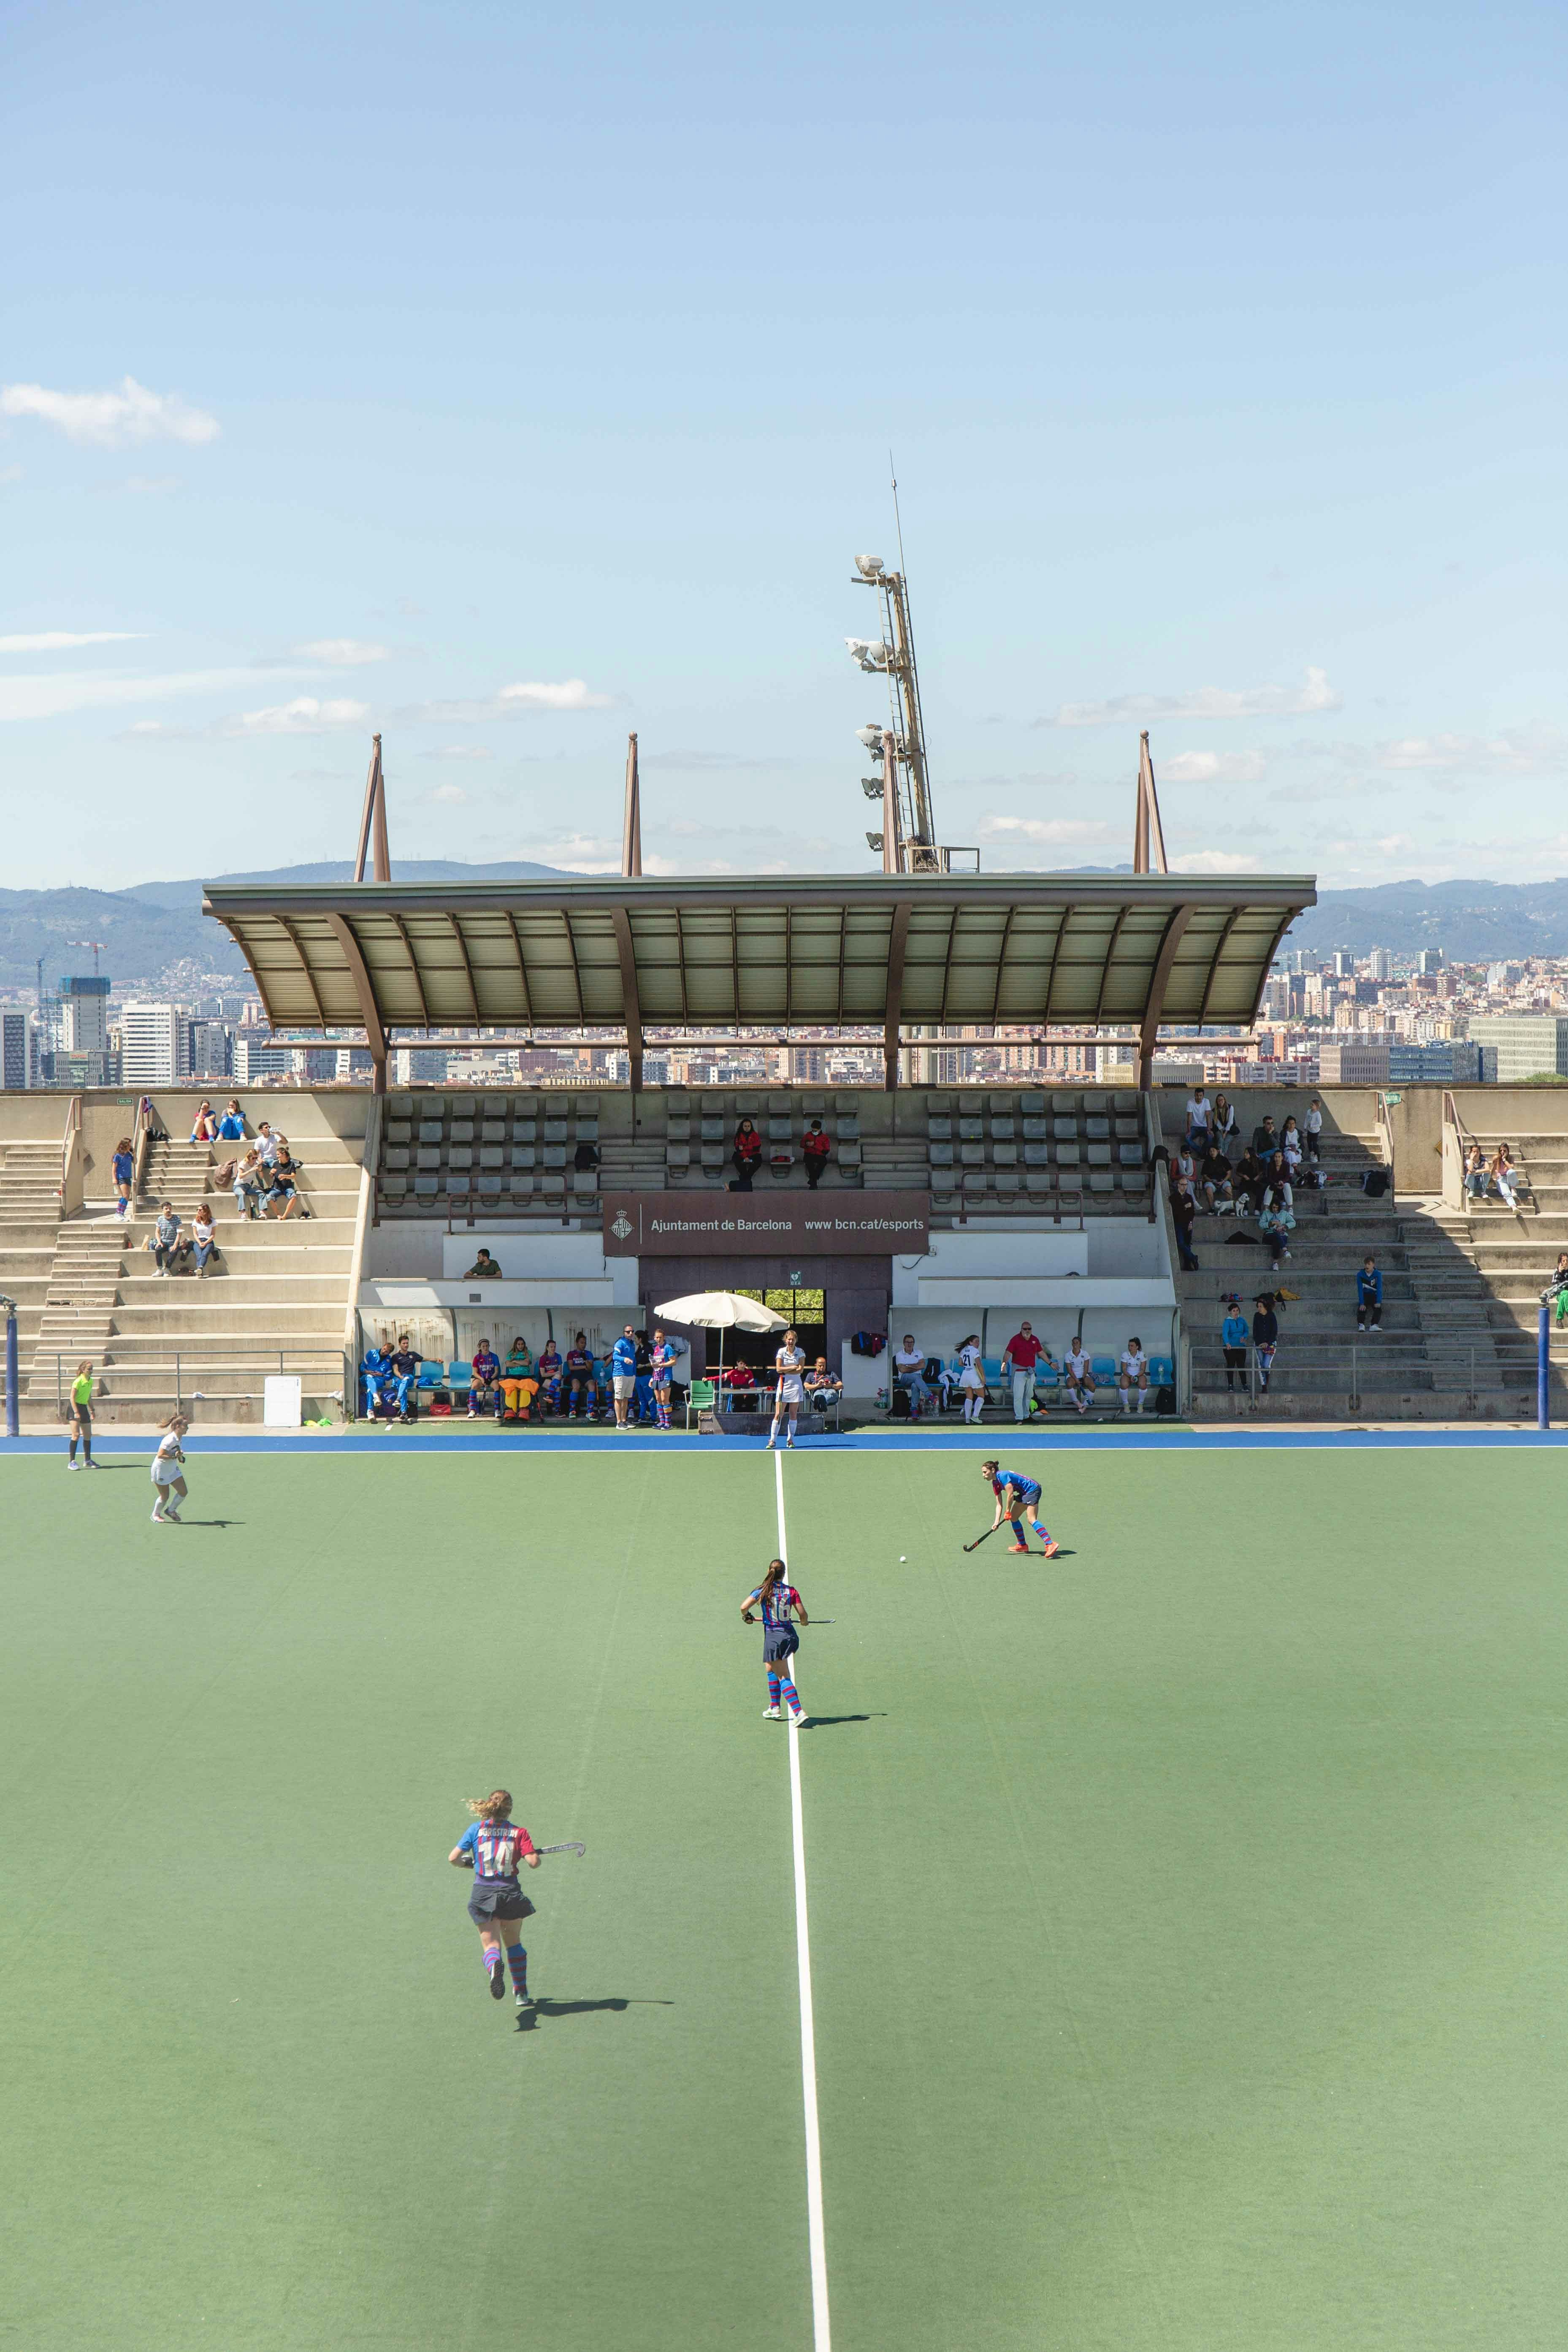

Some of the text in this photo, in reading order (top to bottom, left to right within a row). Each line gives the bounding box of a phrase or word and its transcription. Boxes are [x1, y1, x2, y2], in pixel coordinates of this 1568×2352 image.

[651, 1219, 924, 1233] Ajuntament de Barcelona www bcn.cat/esports
[963, 1354, 971, 1366] 21
[771, 1596, 791, 1621] 16
[478, 1841, 515, 1877] 14
